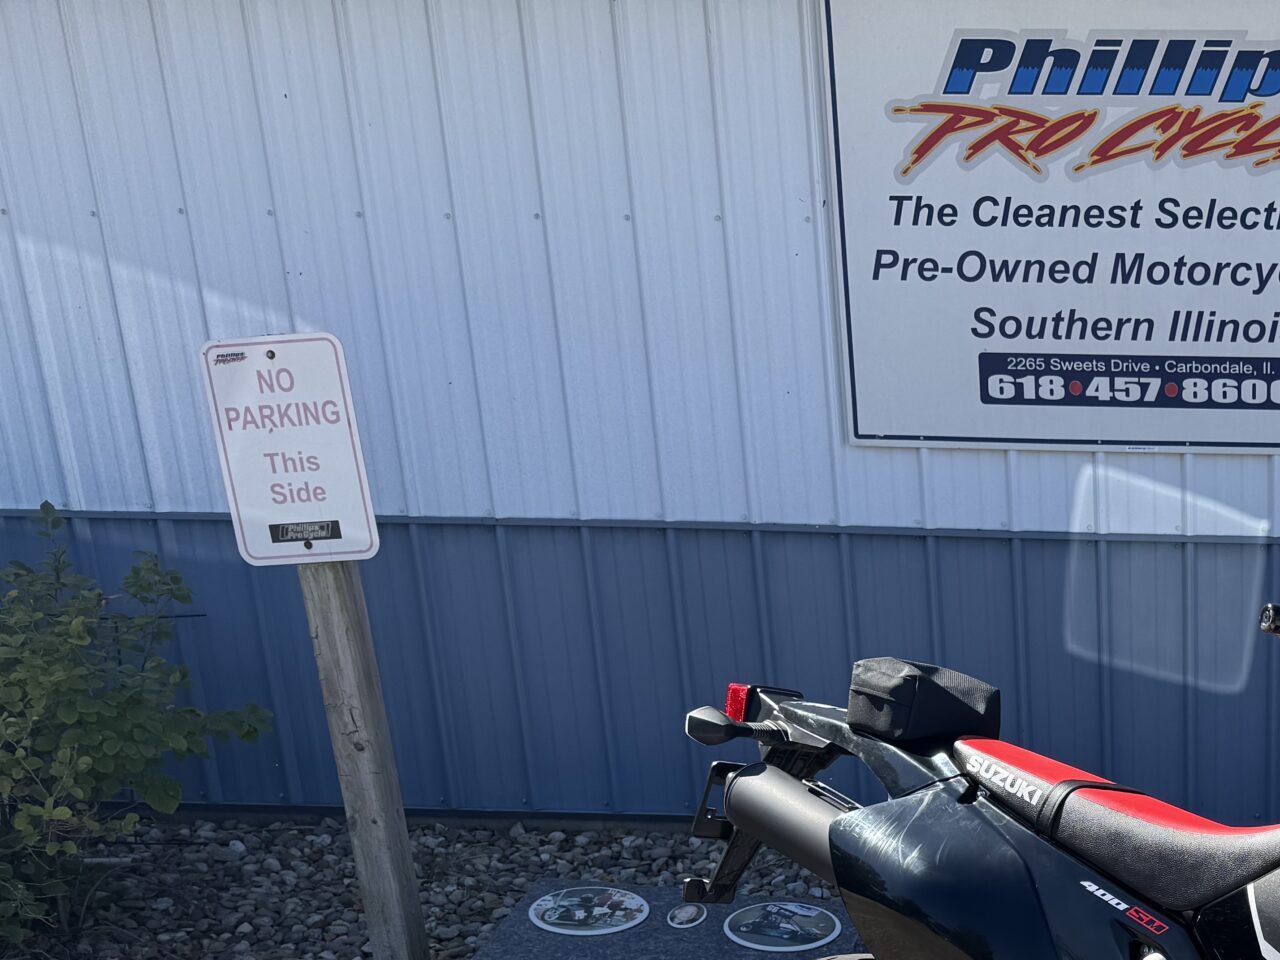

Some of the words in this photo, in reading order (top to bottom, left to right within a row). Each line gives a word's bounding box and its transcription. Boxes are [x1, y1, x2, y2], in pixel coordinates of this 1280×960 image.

[894, 102, 1099, 176] PRO
[888, 196, 958, 227] The
[972, 196, 1142, 229] Cleanest
[872, 249, 1098, 284] Pre-Owned
[971, 307, 1154, 342] Southern
[256, 368, 295, 394] NO
[1007, 357, 1045, 371] 2265
[1050, 357, 1105, 372] Sweets
[1111, 359, 1151, 373] Drive
[1164, 359, 1260, 376] Carbondale,
[224, 399, 341, 431] PARKING
[263, 451, 320, 474] This
[270, 481, 327, 505] Side
[966, 755, 1043, 806] SUZUKI
[1080, 881, 1130, 910] 400
[1126, 907, 1168, 934] SM
